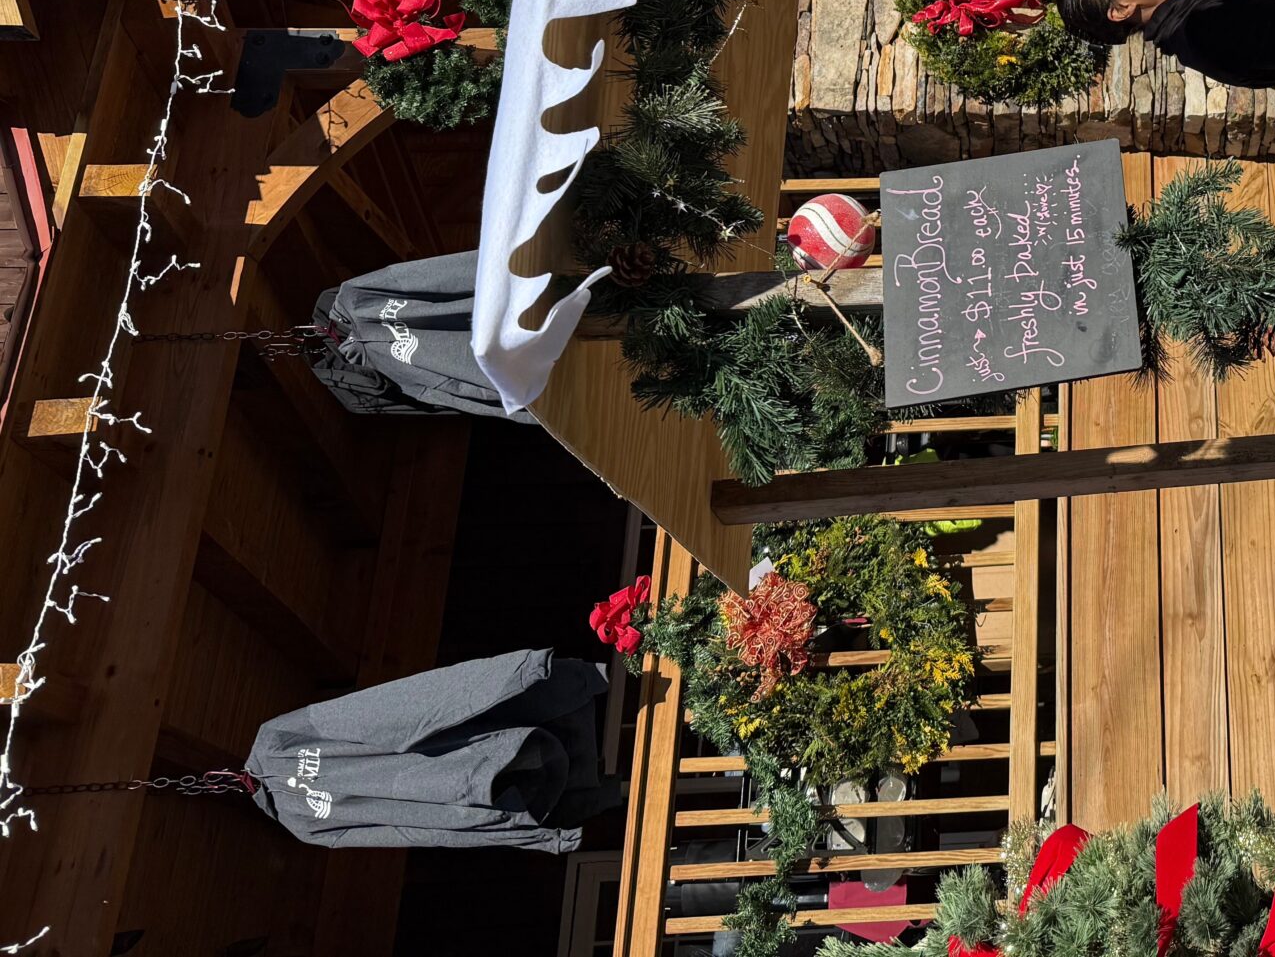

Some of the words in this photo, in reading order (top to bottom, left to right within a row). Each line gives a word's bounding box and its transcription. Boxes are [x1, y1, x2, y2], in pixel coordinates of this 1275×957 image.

[1065, 228, 1086, 244] 15
[1062, 254, 1098, 289] just
[1069, 292, 1089, 316] in
[1004, 279, 1066, 367] freshly
